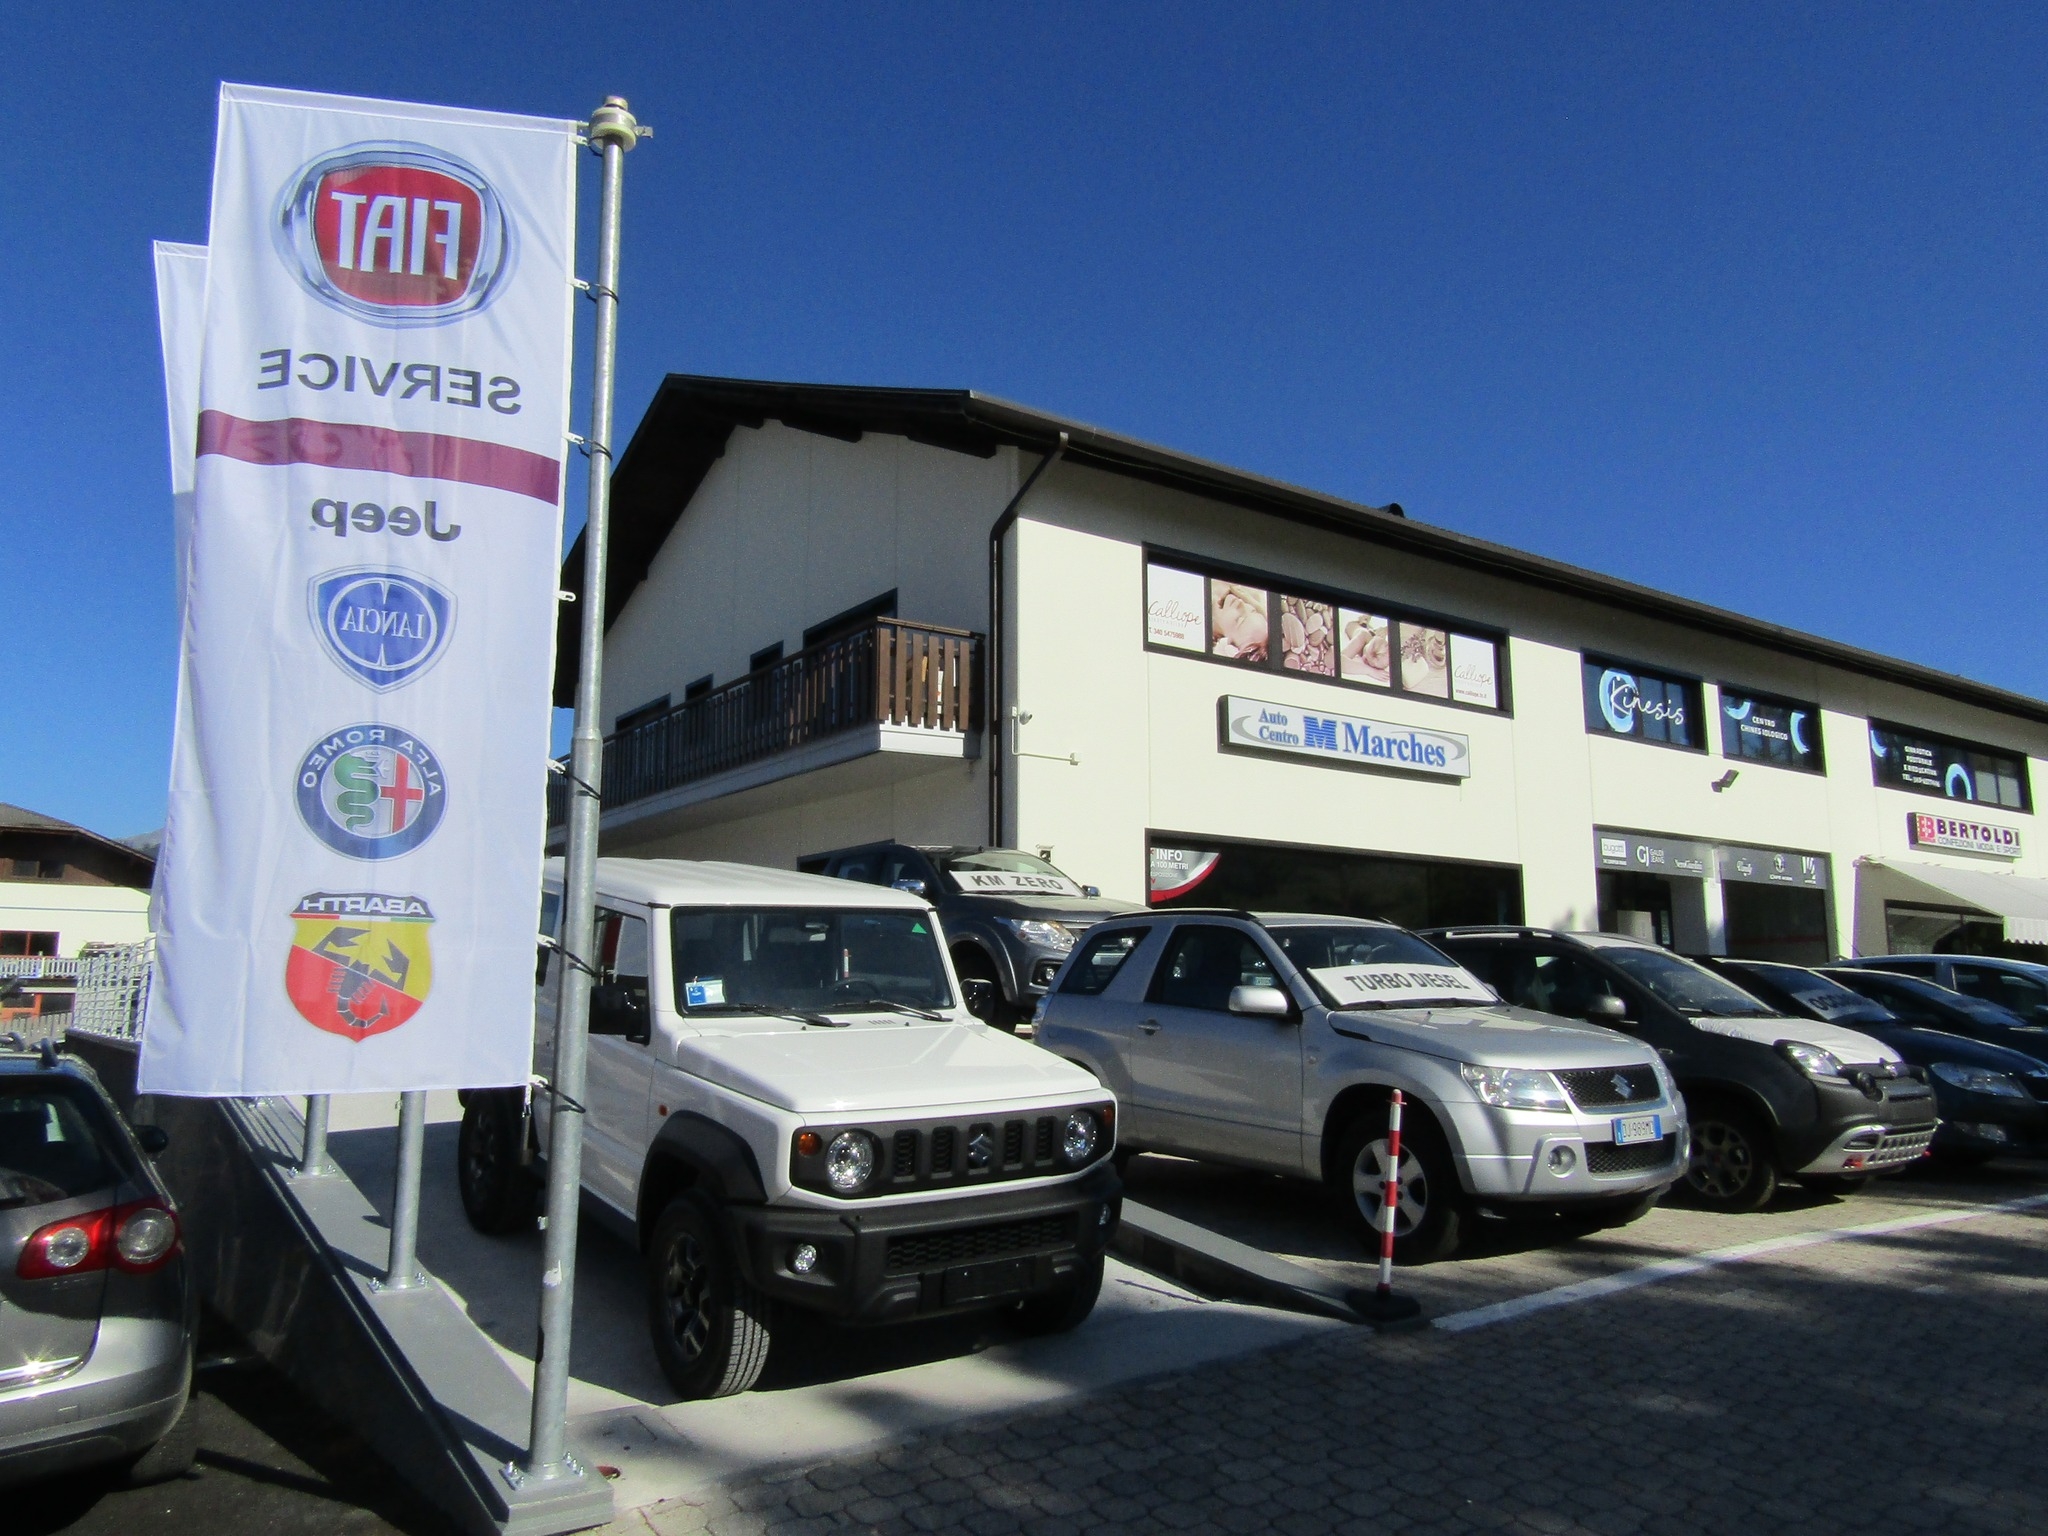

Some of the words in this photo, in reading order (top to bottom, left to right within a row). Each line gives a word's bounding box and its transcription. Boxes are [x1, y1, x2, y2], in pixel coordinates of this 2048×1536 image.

[1610, 676, 1684, 725] Kinesis
[1258, 707, 1288, 725] Auto
[1752, 716, 1775, 727] CENTRO
[1258, 725, 1299, 745] Centro
[1342, 721, 1446, 768] Marches
[1936, 818, 2020, 846] BERTOLDI
[1156, 848, 1183, 861] INFO
[1157, 861, 1168, 869] 100
[1168, 862, 1189, 870] METRI
[971, 875, 1004, 886] KM
[1010, 876, 1063, 890] ZERO
[1344, 972, 1412, 992] TURBO
[1408, 972, 1471, 990] DIESEL
